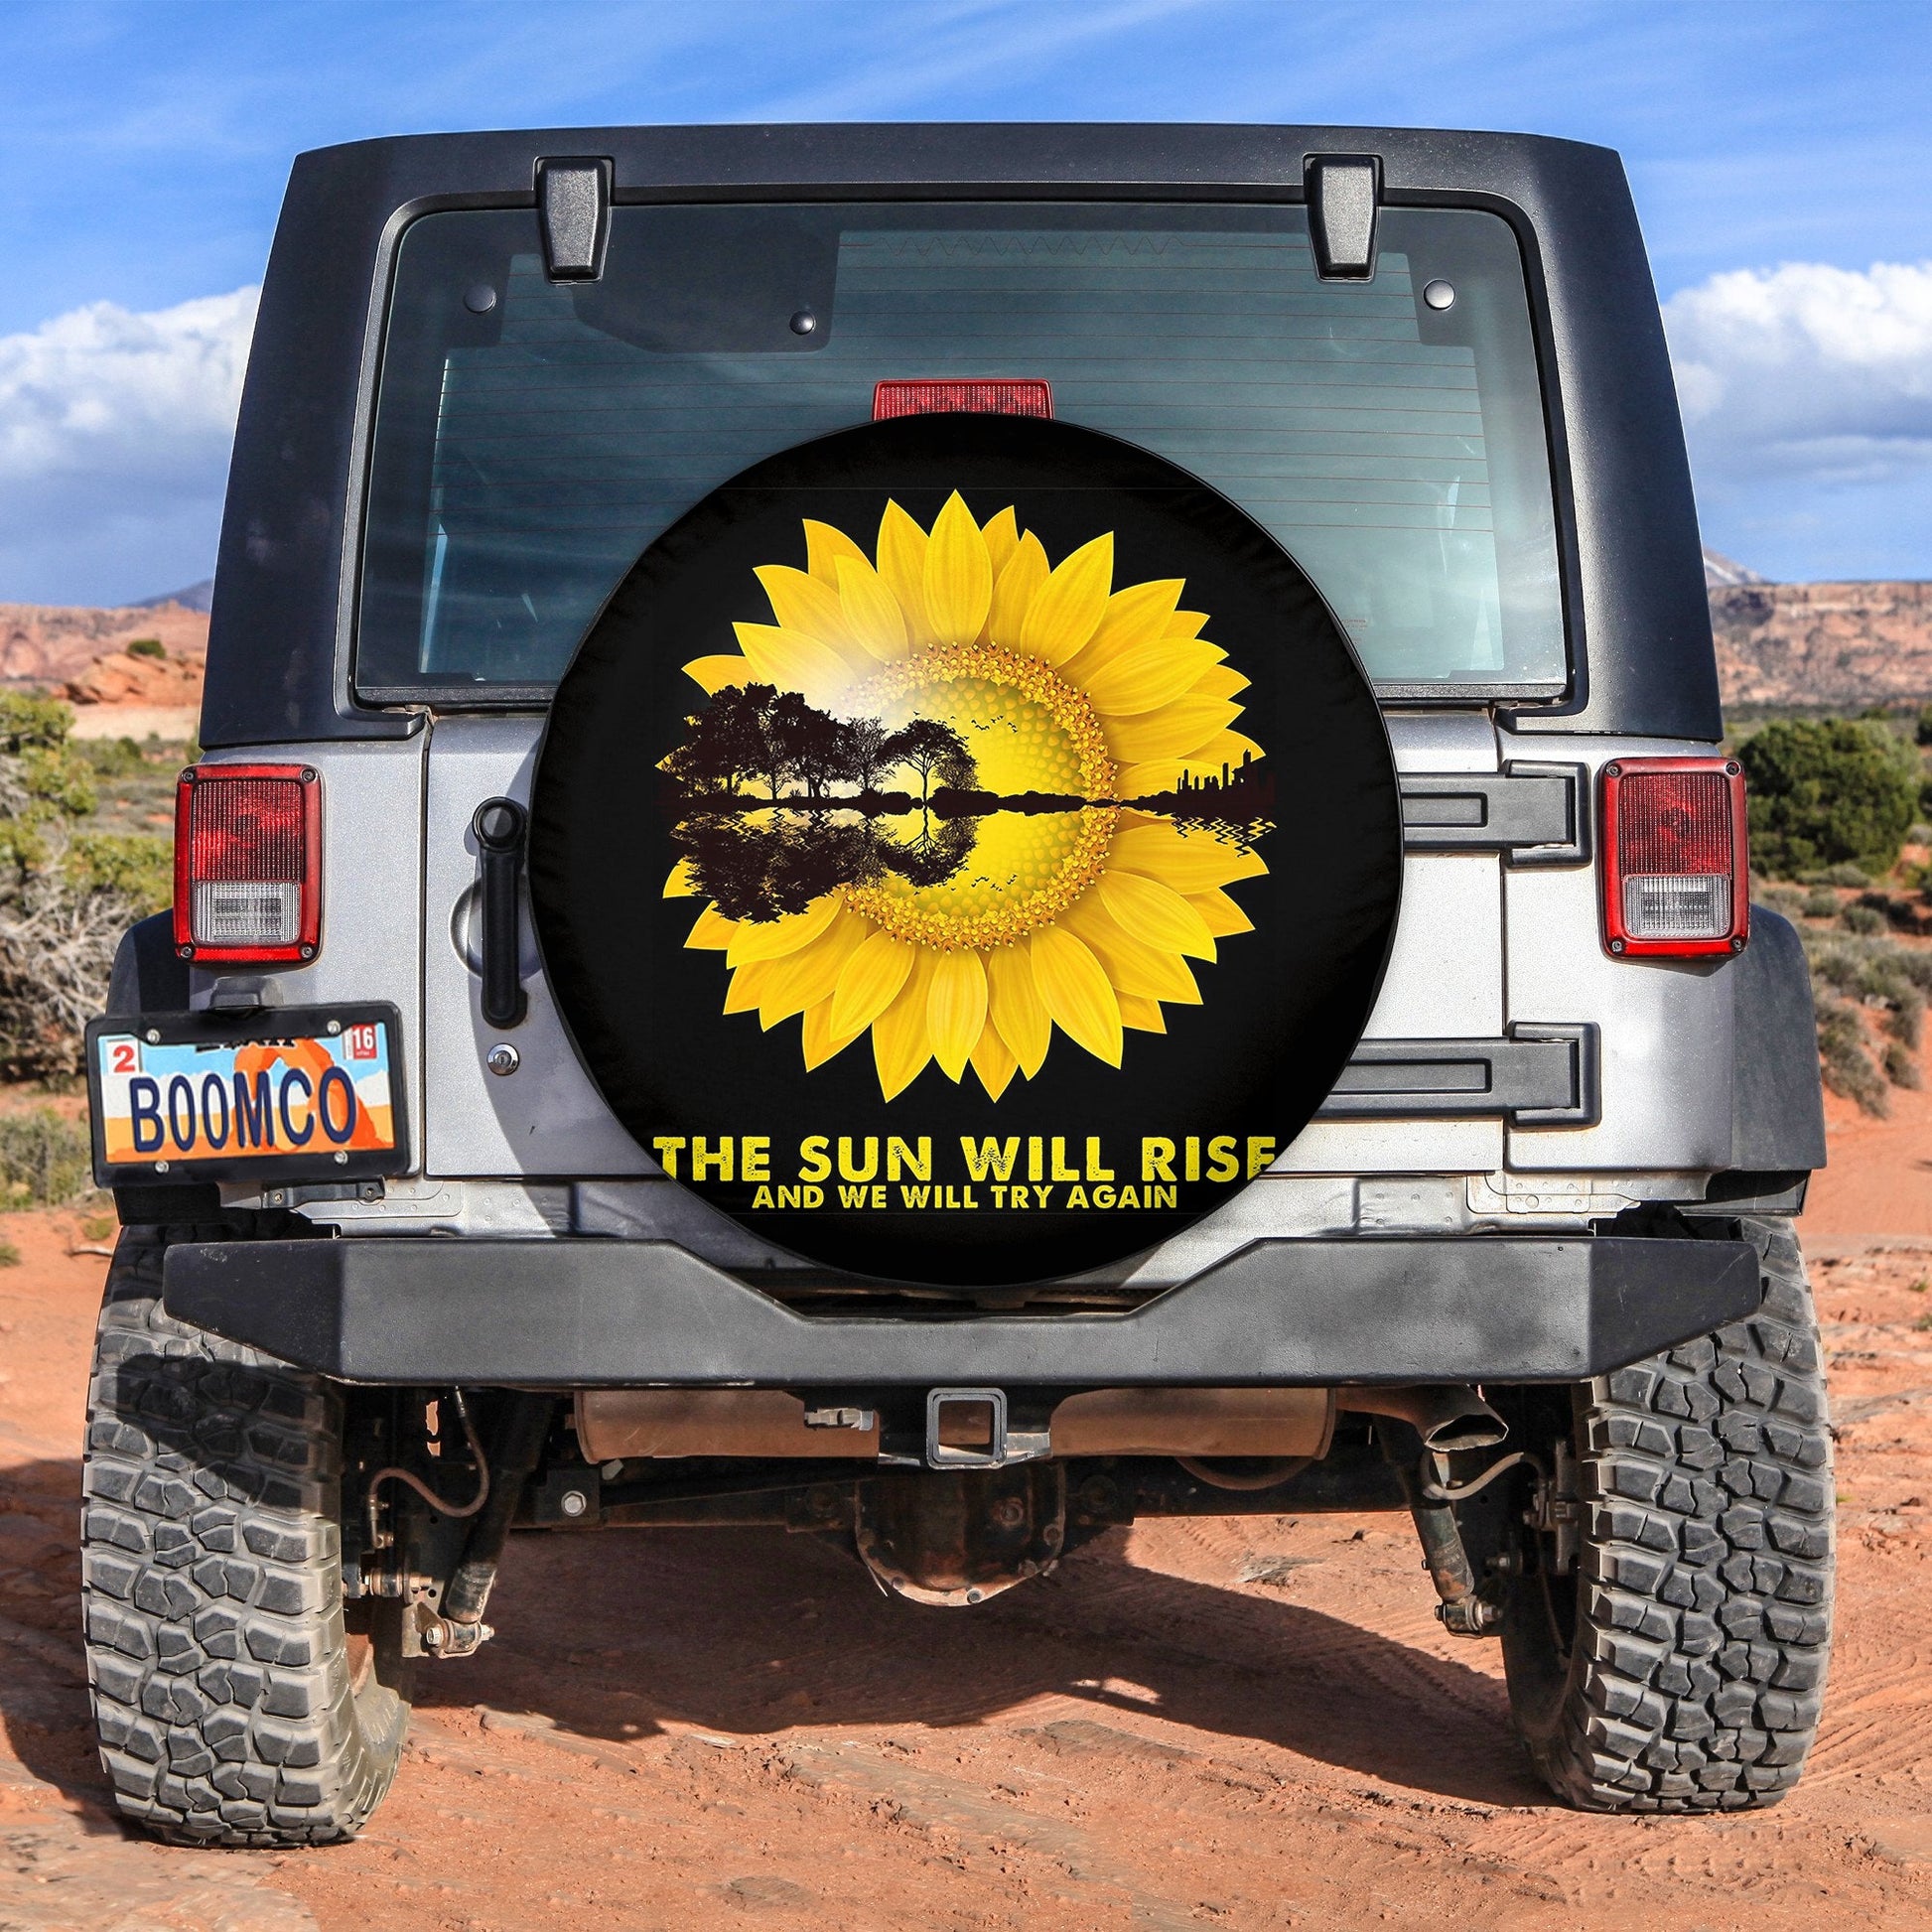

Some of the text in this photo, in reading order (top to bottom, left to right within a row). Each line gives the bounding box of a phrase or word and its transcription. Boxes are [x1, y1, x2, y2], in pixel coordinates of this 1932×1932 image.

[353, 1027, 374, 1050] 16
[113, 1044, 136, 1073] 2
[652, 1135, 1276, 1183] THE SUN WILL RISE
[752, 1184, 1177, 1209] AND WE WILL TRY AGAIN
